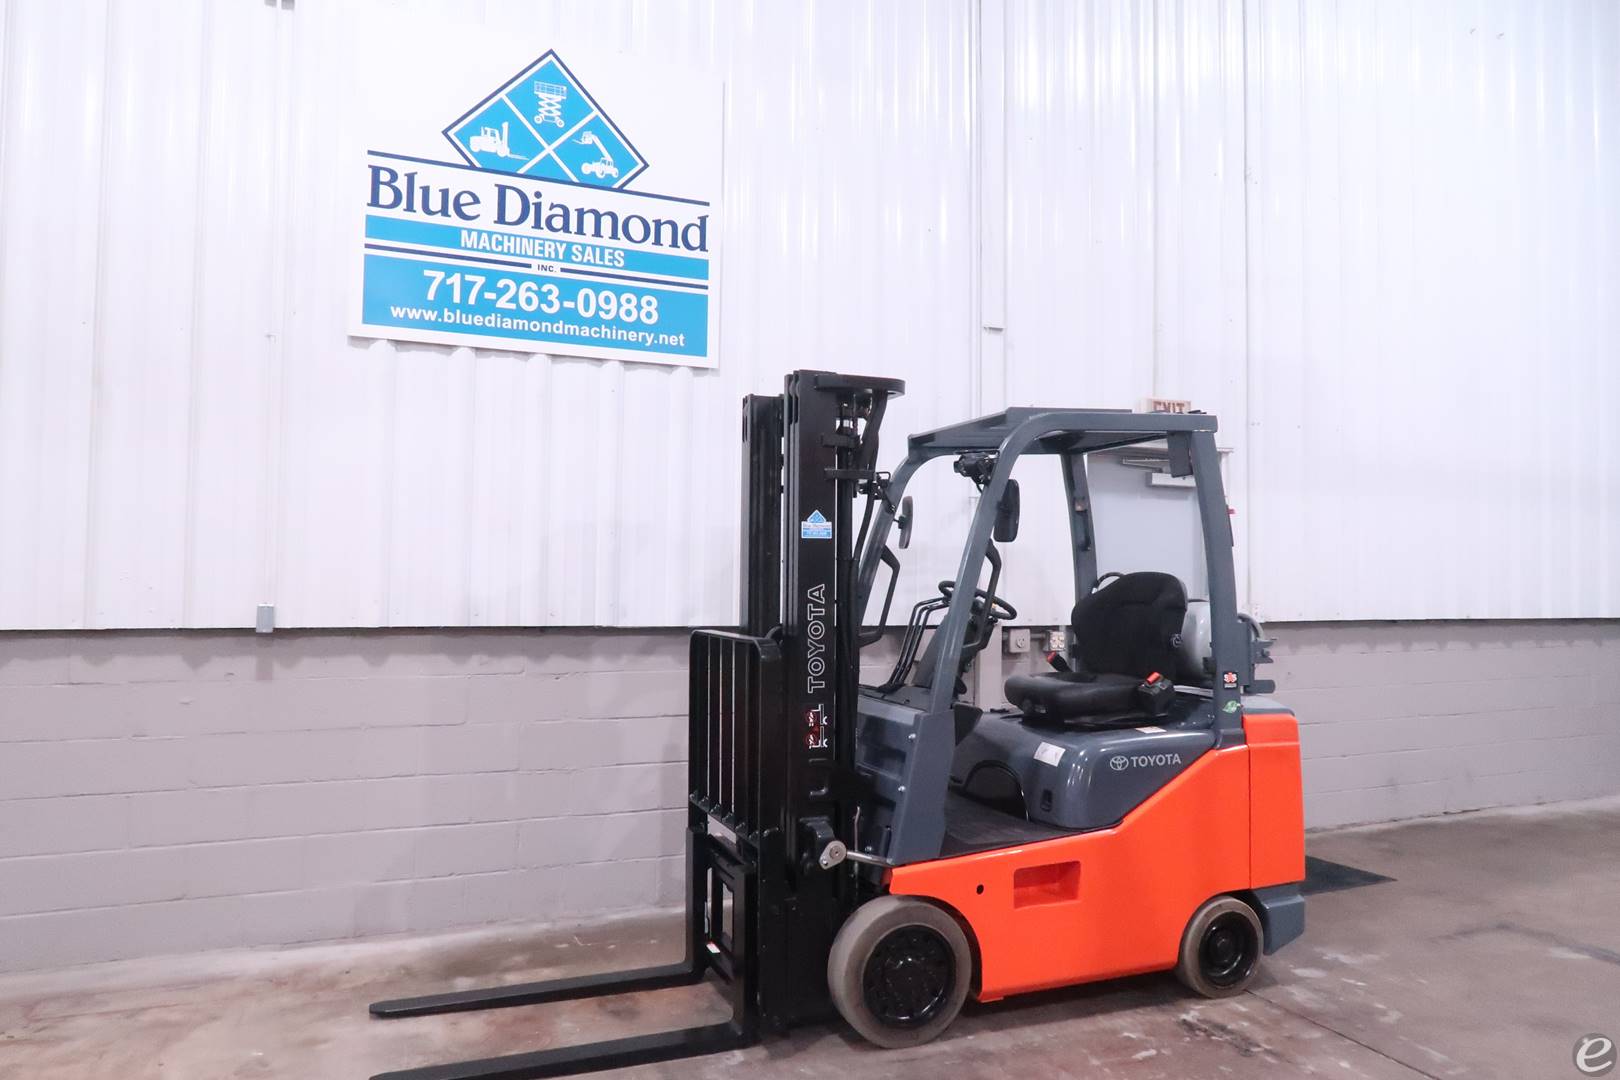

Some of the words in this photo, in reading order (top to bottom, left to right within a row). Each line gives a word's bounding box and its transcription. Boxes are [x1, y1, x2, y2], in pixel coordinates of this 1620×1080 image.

[366, 164, 481, 221] Blue
[493, 183, 710, 253] Diamond
[460, 229, 567, 261] MACHINERY
[571, 245, 625, 267] SALES
[537, 263, 557, 273] INC.
[422, 269, 659, 325] 717-263-0988
[390, 303, 685, 347] www.bluediamondmachinery.net
[807, 583, 825, 694] TOYOTA
[1130, 753, 1182, 768] TOYOTA
